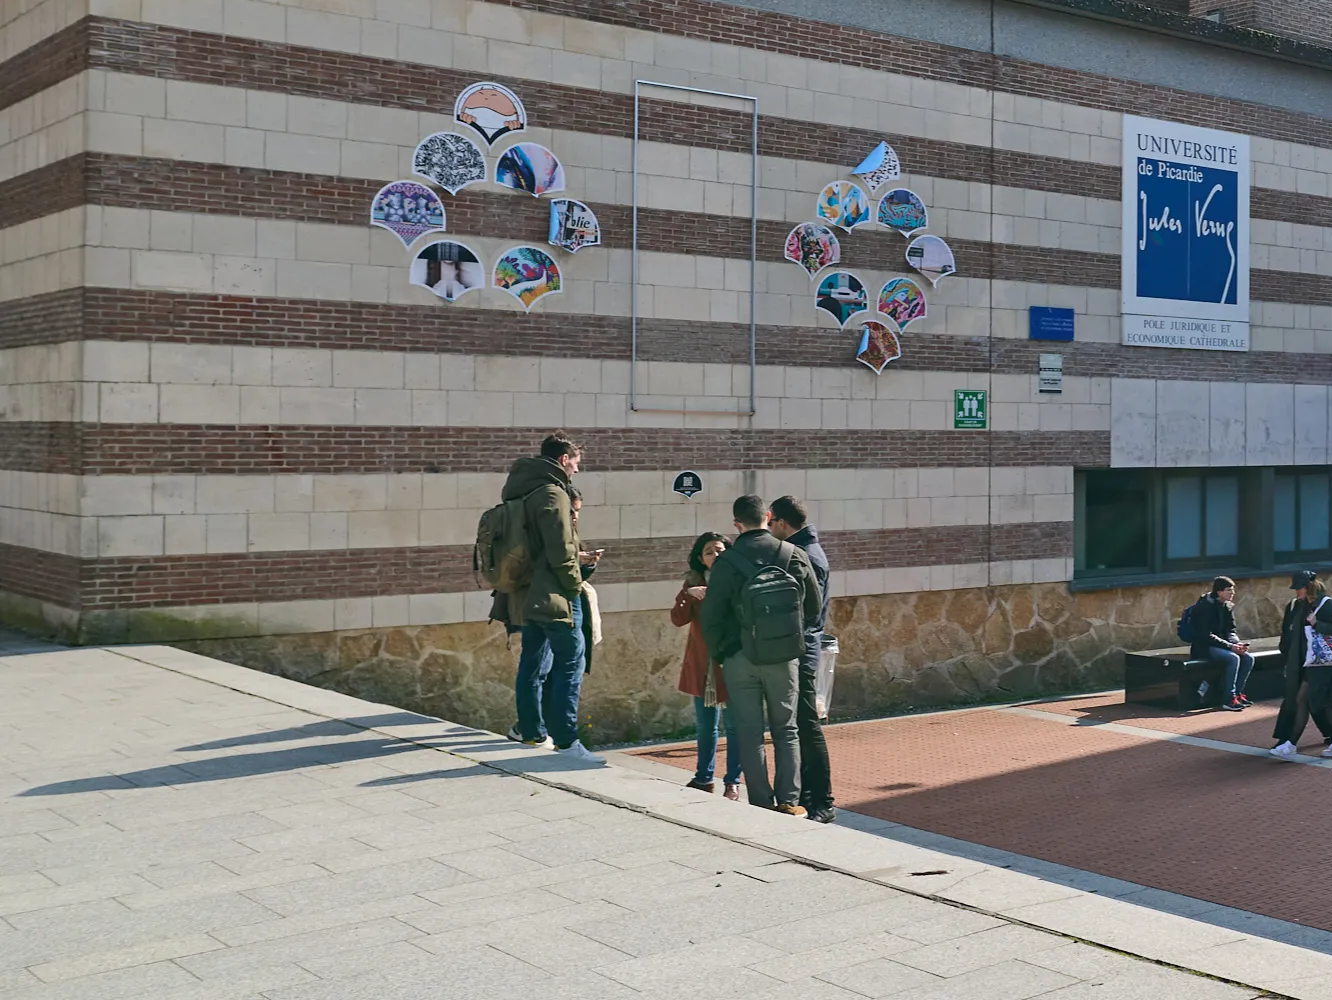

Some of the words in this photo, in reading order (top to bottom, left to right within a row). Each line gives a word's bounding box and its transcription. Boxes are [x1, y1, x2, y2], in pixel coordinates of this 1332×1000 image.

[1136, 133, 1238, 165] UNIVERSITÉ
[1138, 160, 1153, 176] de
[1157, 161, 1204, 183] Picardie
[1139, 190, 1182, 251] Jules
[1195, 183, 1235, 304] Verne
[1143, 320, 1165, 329] POLE
[1170, 321, 1216, 333] JURIDIQUE
[1220, 324, 1231, 333] ET
[1127, 333, 1186, 345] ECONOMIQUE
[1190, 336, 1246, 348] CATHEDRALE
